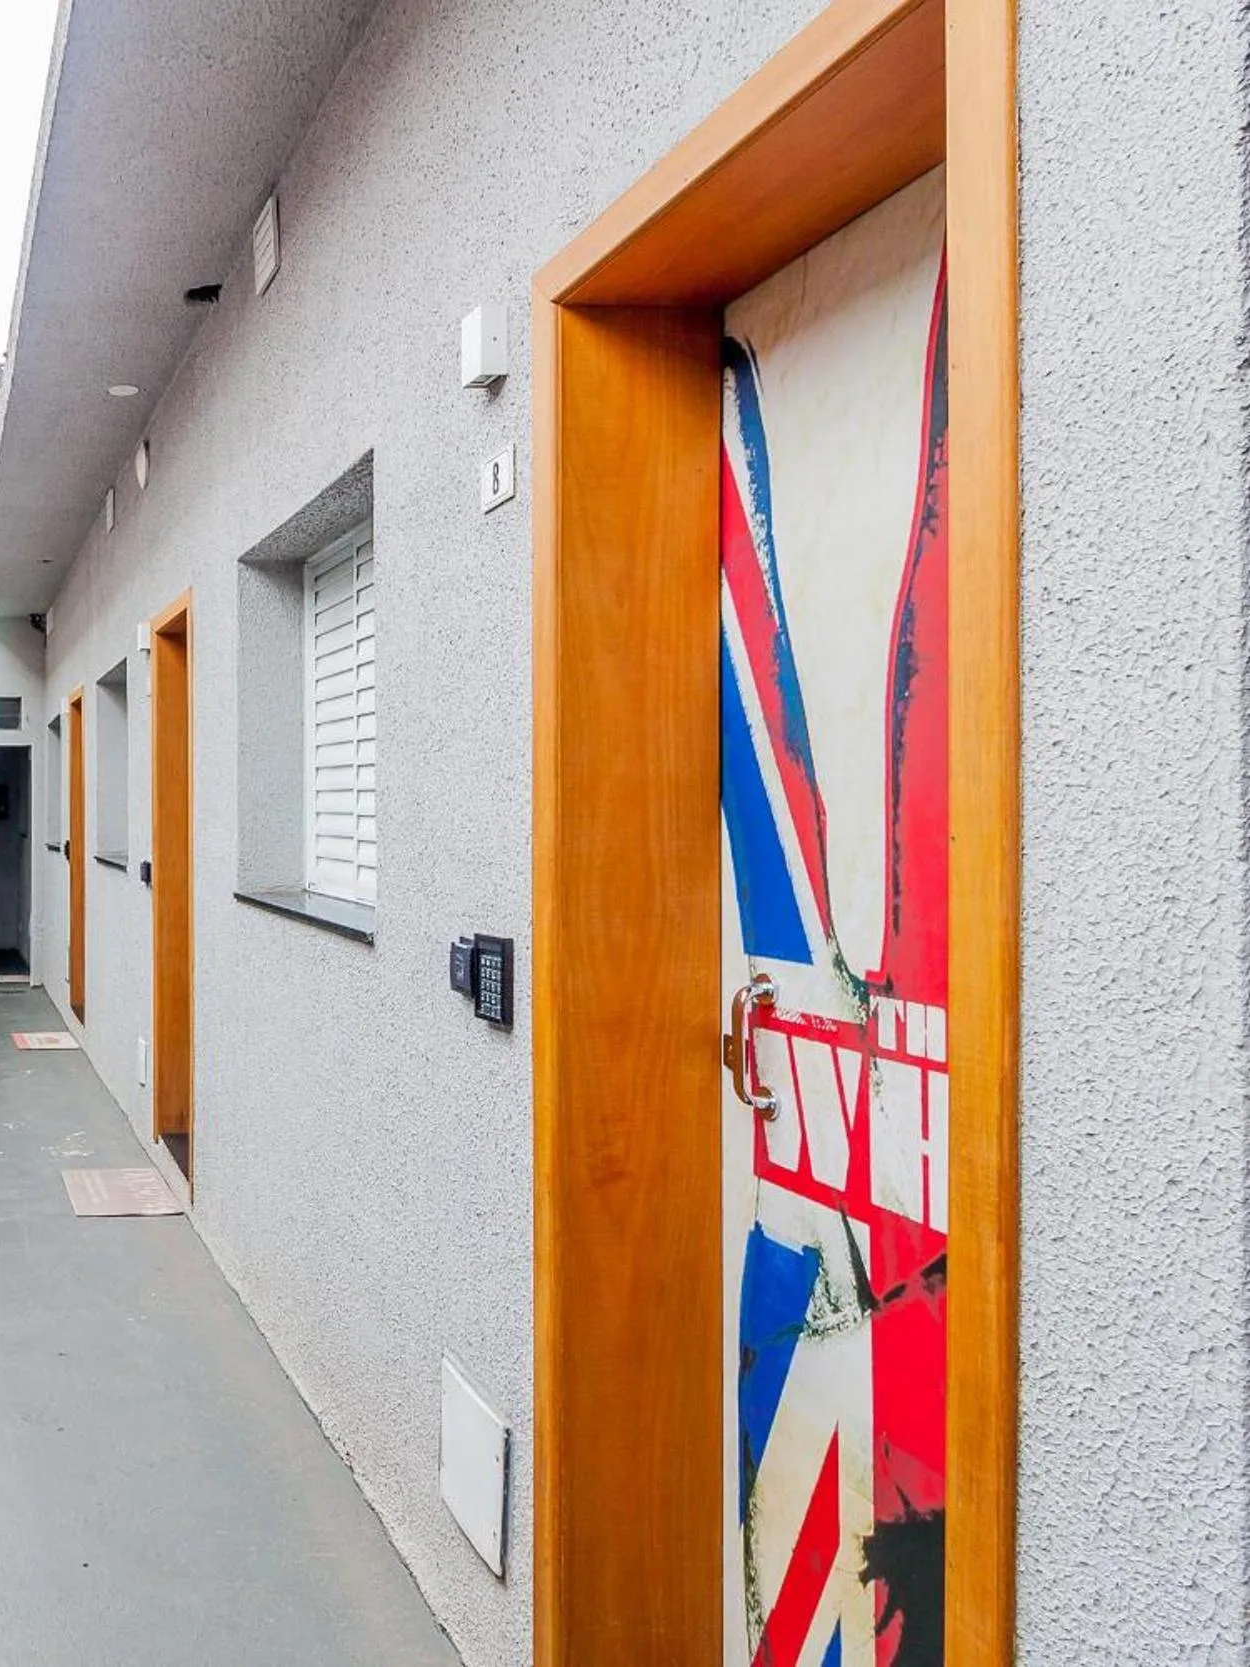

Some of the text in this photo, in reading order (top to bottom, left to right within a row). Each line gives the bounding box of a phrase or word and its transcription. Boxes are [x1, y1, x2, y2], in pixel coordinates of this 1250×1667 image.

[493, 462, 499, 494] 8
[870, 995, 947, 1063] TH
[753, 1028, 948, 1234] WH
